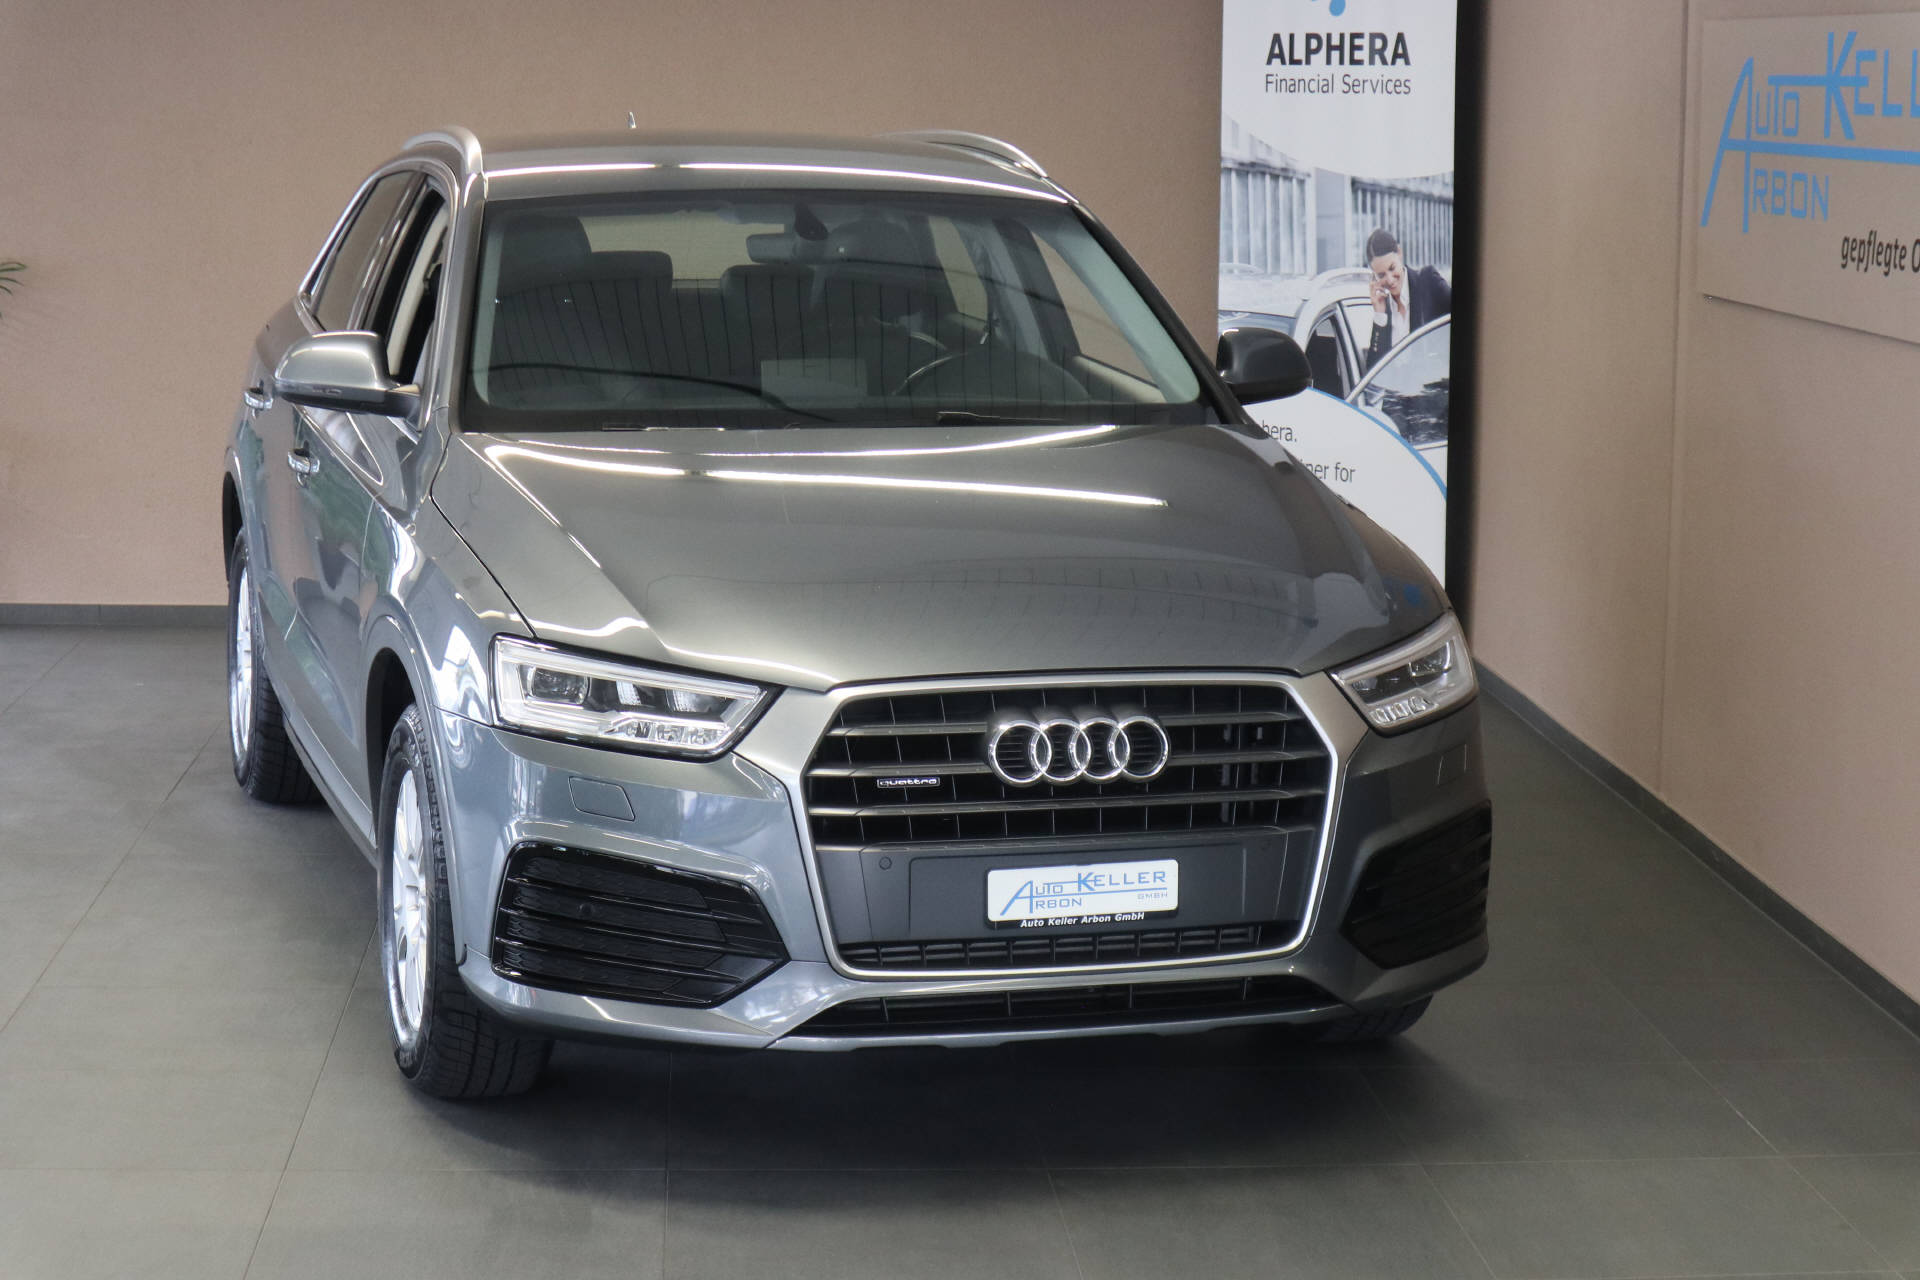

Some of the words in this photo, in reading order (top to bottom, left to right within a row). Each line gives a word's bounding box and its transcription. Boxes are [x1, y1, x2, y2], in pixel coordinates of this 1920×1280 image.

[1266, 32, 1411, 66] ALPHERA
[1265, 73, 1334, 94] Financial
[1342, 74, 1411, 95] Services
[1823, 31, 1920, 140] KELL
[1841, 229, 1907, 277] gepflegte
[1261, 419, 1297, 442] hera.
[1335, 462, 1355, 483] for
[879, 778, 938, 788] quattro
[1077, 871, 1166, 892] KELLER
[1020, 918, 1045, 929] Auto
[1048, 916, 1077, 927] Keller
[1081, 914, 1111, 925] Arbon
[1115, 912, 1145, 922] GmbH
